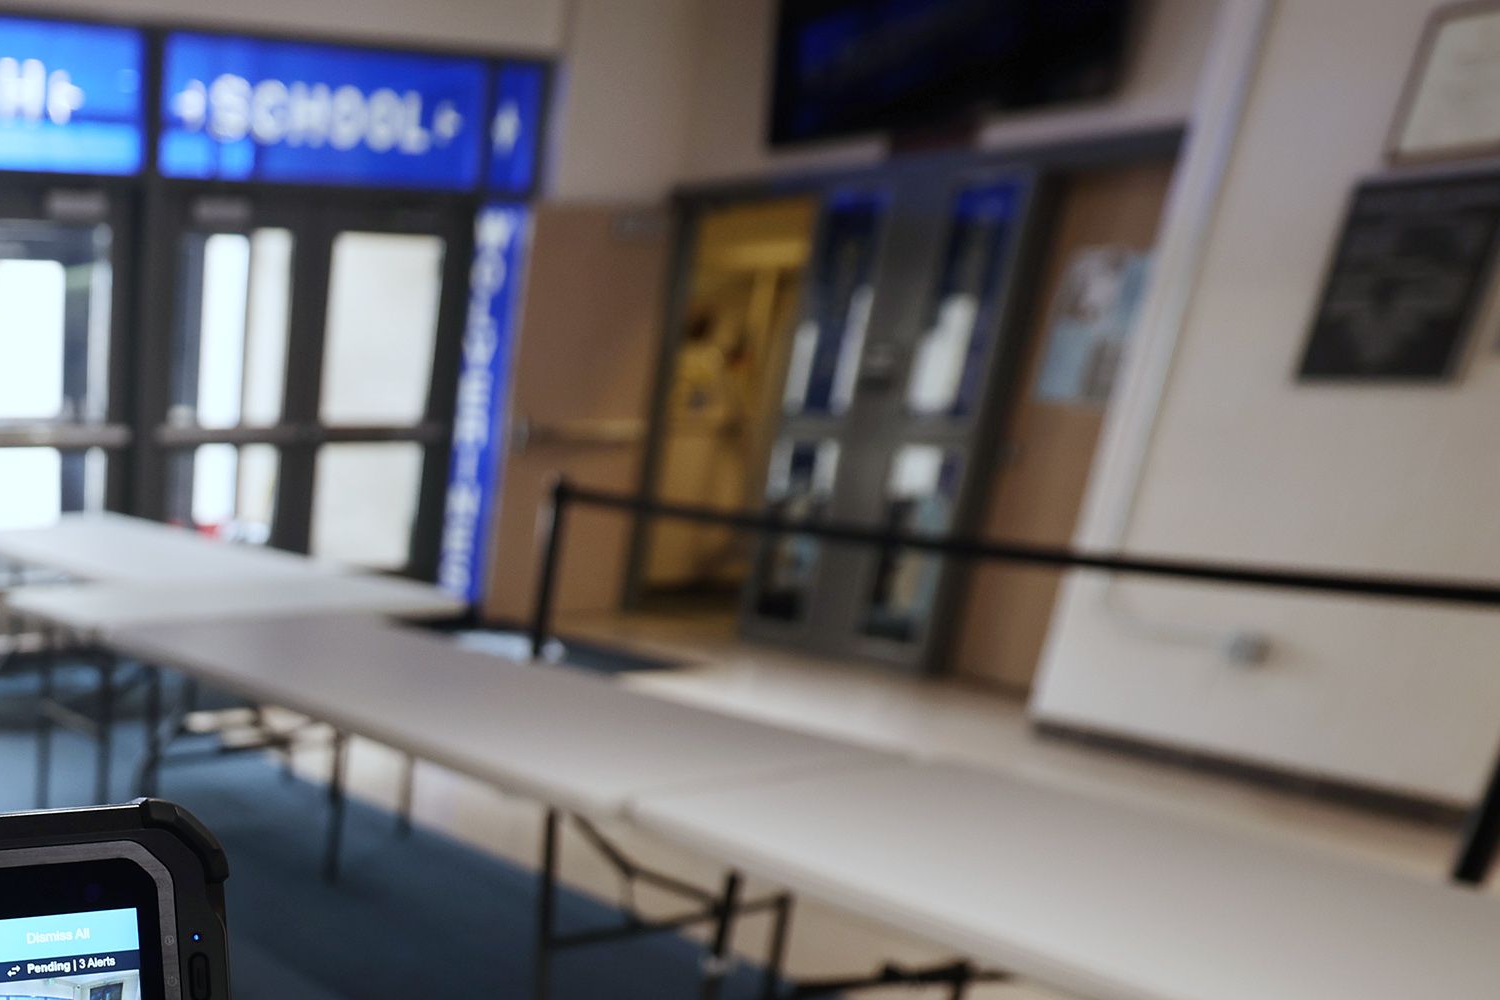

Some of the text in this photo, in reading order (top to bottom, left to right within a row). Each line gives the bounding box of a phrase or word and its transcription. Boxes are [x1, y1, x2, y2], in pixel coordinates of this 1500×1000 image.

[209, 73, 431, 154] SCHOOL
[26, 928, 90, 945] Dismiss All
[26, 960, 71, 975] Pending
[79, 959, 86, 969] 3
[87, 956, 116, 968] Alerts
